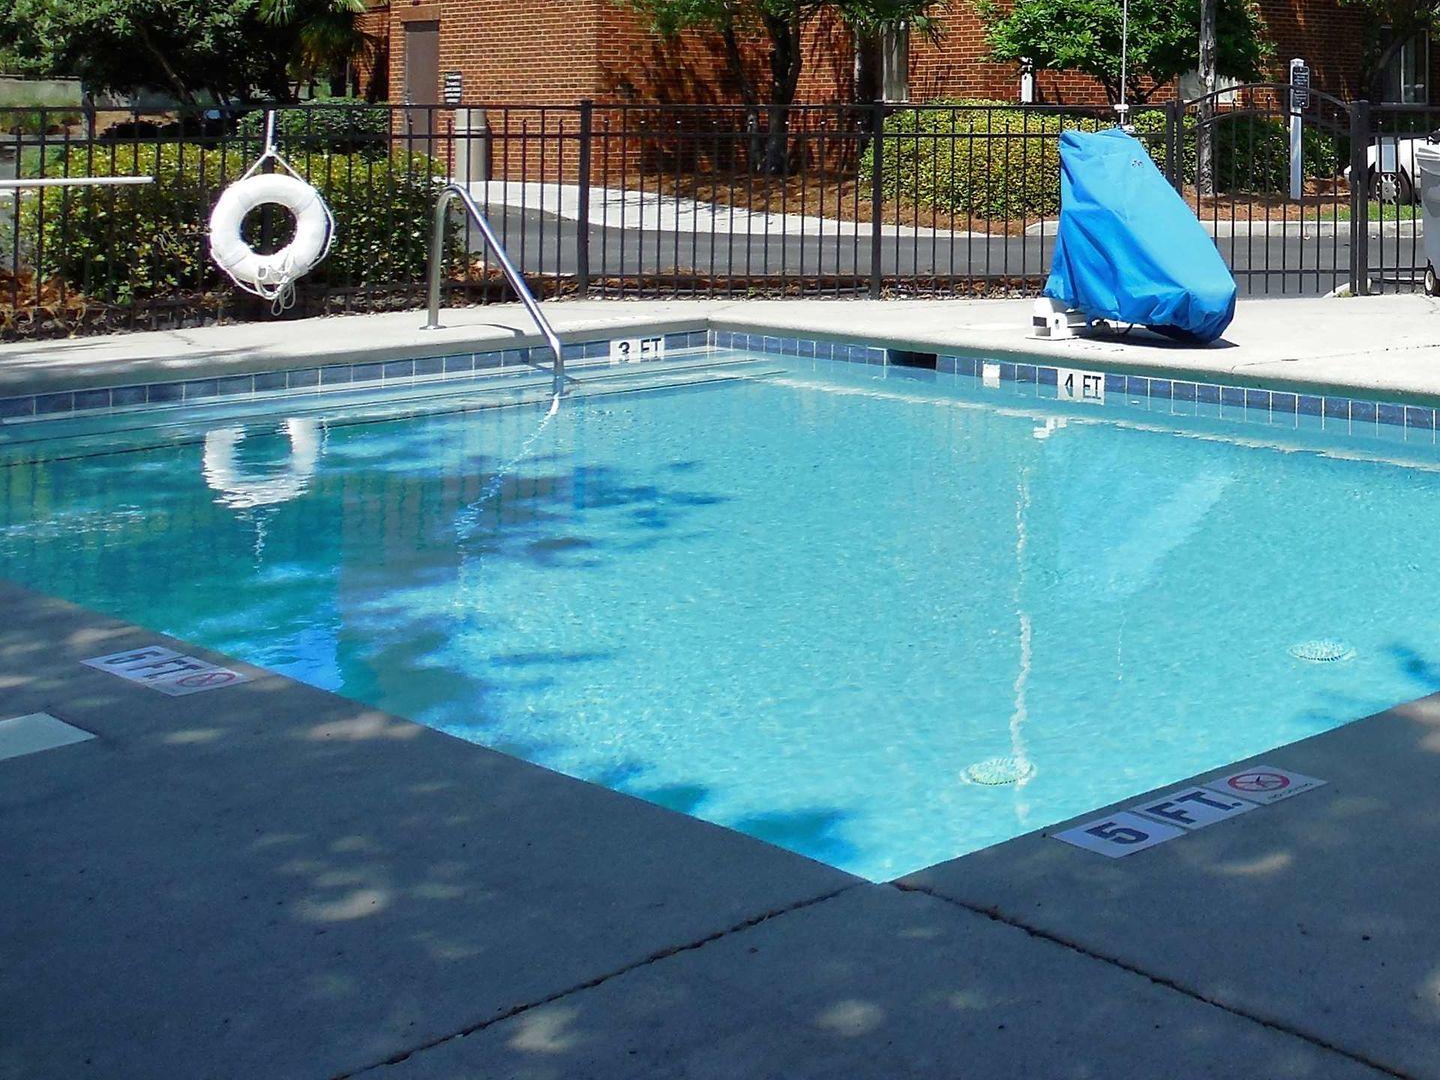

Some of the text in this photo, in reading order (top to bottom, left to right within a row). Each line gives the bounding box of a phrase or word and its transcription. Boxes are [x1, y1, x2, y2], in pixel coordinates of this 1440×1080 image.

[640, 337, 662, 352] FT
[1084, 821, 1150, 846] 5
[1145, 790, 1243, 825] FT.
